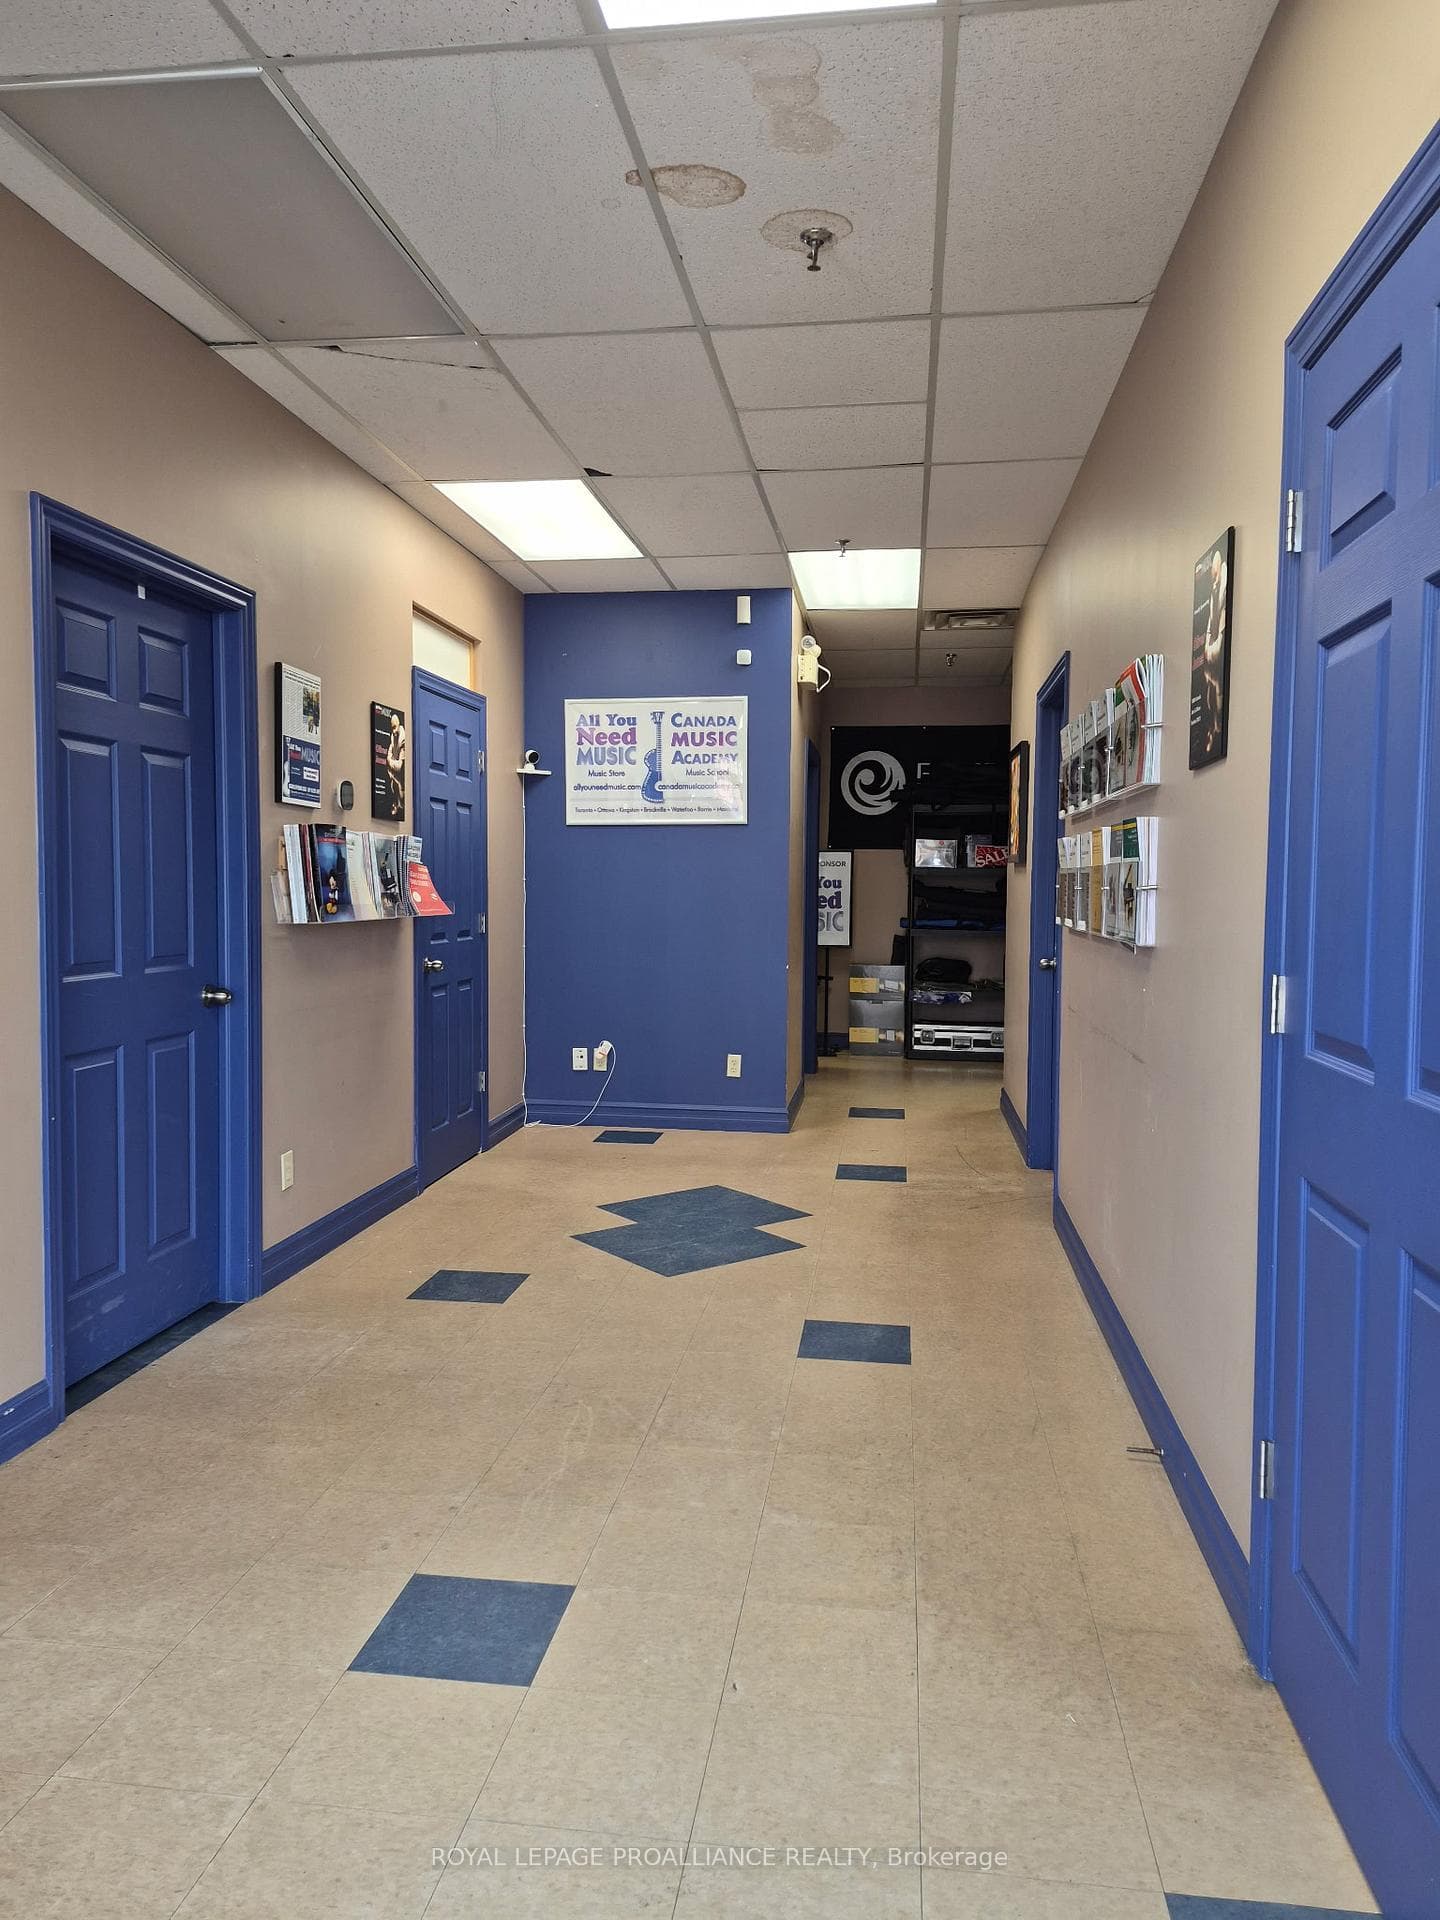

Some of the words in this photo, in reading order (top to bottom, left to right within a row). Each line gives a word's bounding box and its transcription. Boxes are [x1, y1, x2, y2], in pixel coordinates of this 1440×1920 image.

[576, 713, 600, 726] All
[606, 713, 637, 726] You
[671, 713, 737, 728] CANADA
[576, 727, 637, 746] Need
[671, 731, 738, 747] MUSIC
[576, 746, 637, 766] MUSIC
[671, 750, 739, 765] ACADEMY
[588, 769, 607, 777] Music
[609, 769, 626, 777] Store
[686, 768, 706, 777] Music
[818, 890, 843, 909] ed
[818, 911, 844, 932] SIC
